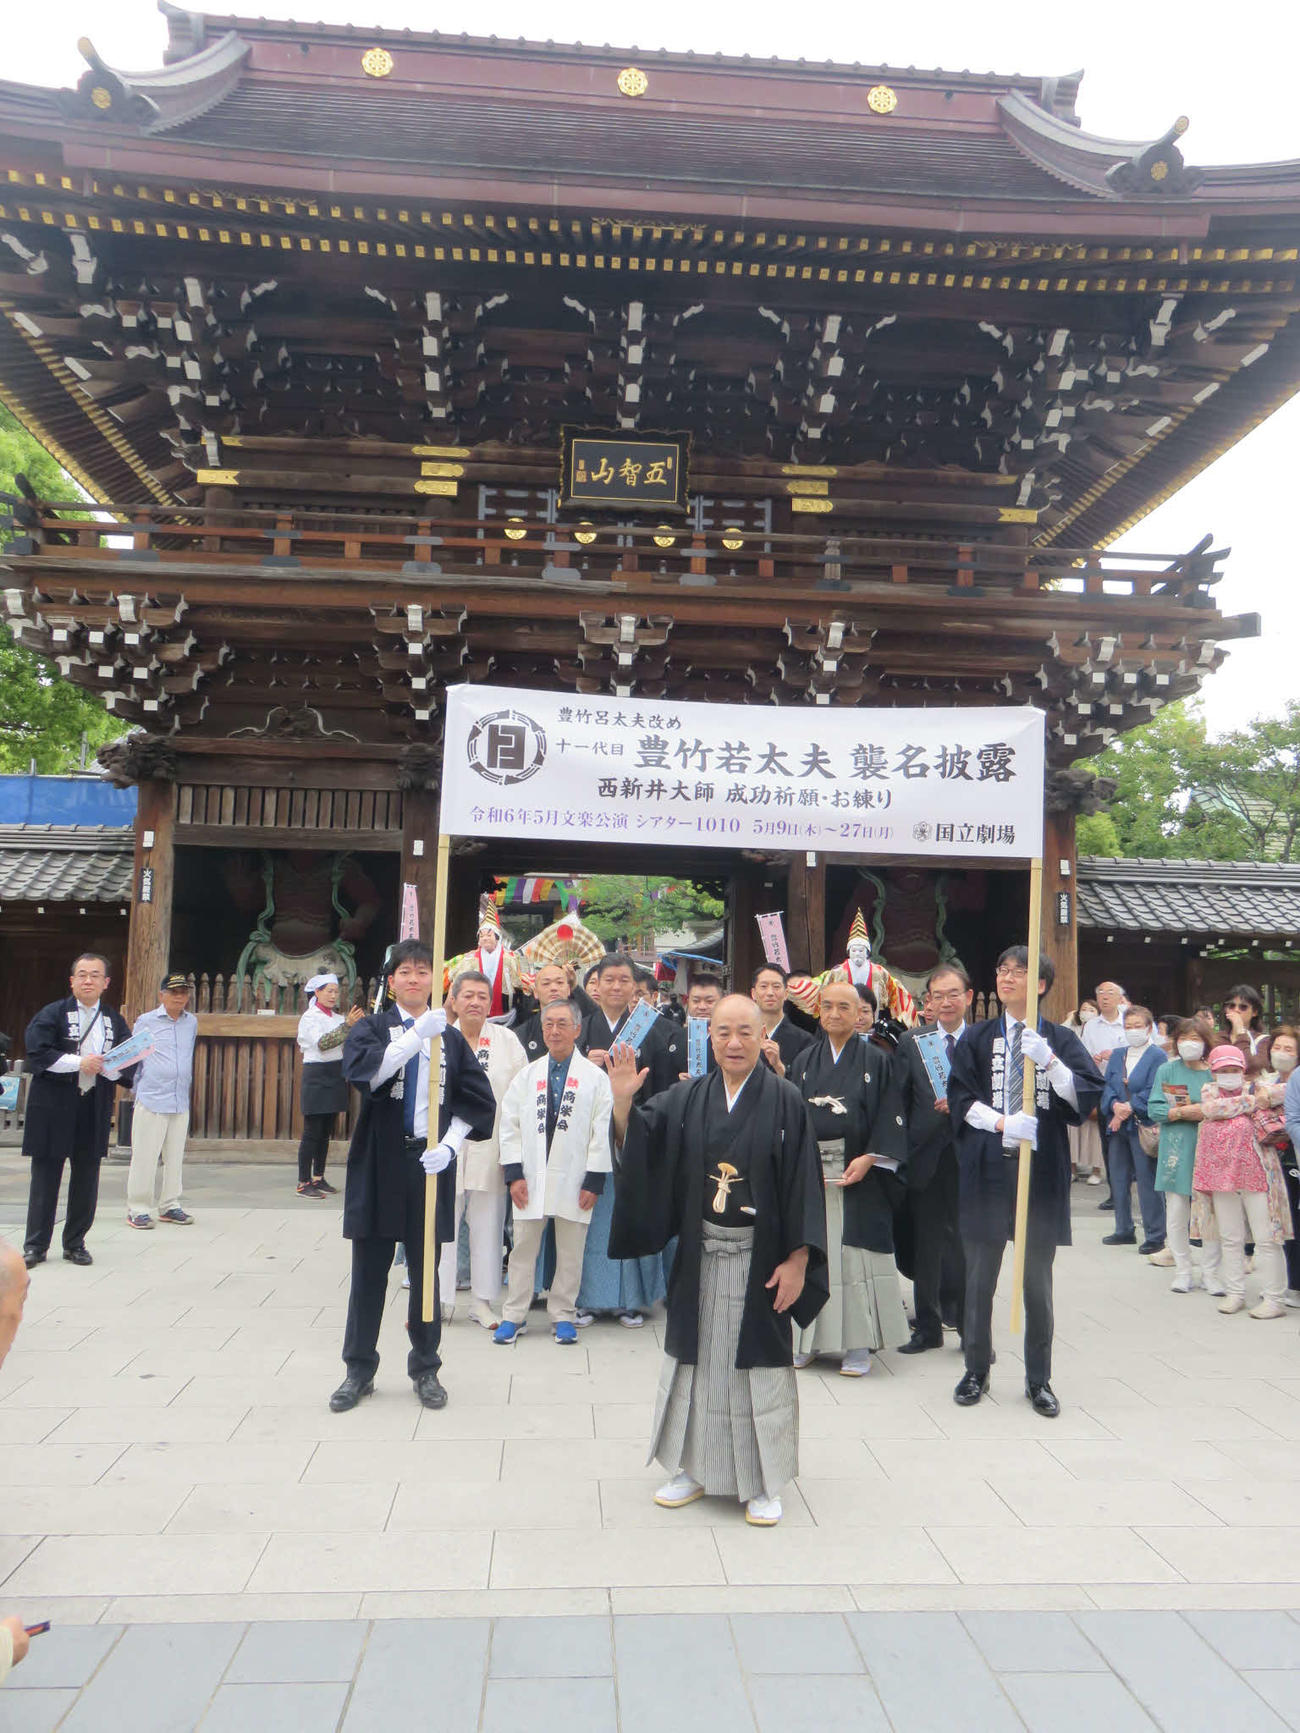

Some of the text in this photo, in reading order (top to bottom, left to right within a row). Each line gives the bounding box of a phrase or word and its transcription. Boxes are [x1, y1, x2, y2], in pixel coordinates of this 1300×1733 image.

[557, 706, 682, 730] 豊竹呂太夫改め
[555, 733, 1017, 783] 十一代目 豊竹若太夫 襲名披露
[598, 776, 893, 810] 西新井大師 成功祈願・お練り
[470, 805, 629, 830] 令和6年5月文楽公演
[636, 814, 741, 833] シアター1010
[936, 823, 1015, 845] 国立劇場
